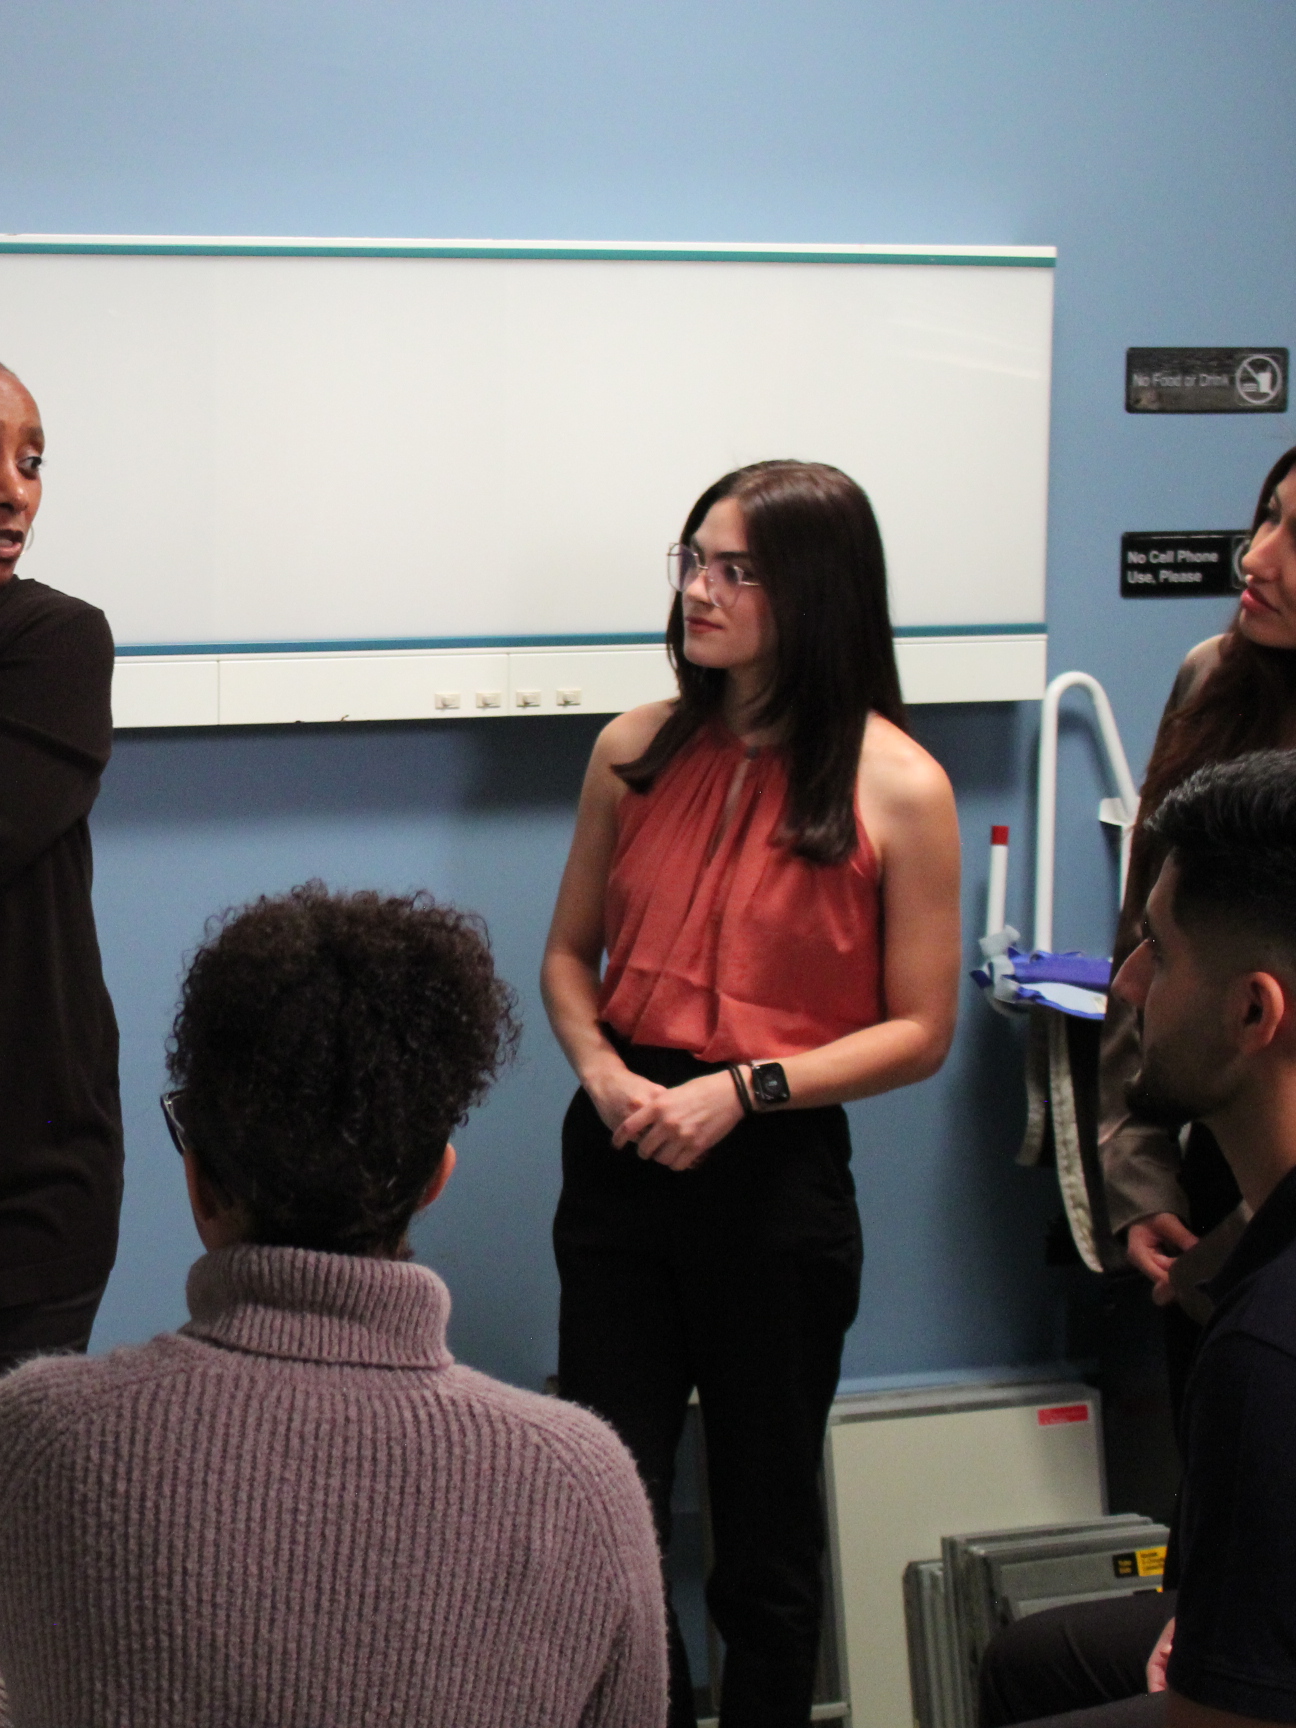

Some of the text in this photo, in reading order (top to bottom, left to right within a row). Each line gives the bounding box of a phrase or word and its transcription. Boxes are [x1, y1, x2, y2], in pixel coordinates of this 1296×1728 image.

[1132, 372, 1230, 387] No Food or Drink
[1127, 549, 1219, 564] No Cell Phone
[1159, 569, 1203, 583] Please
